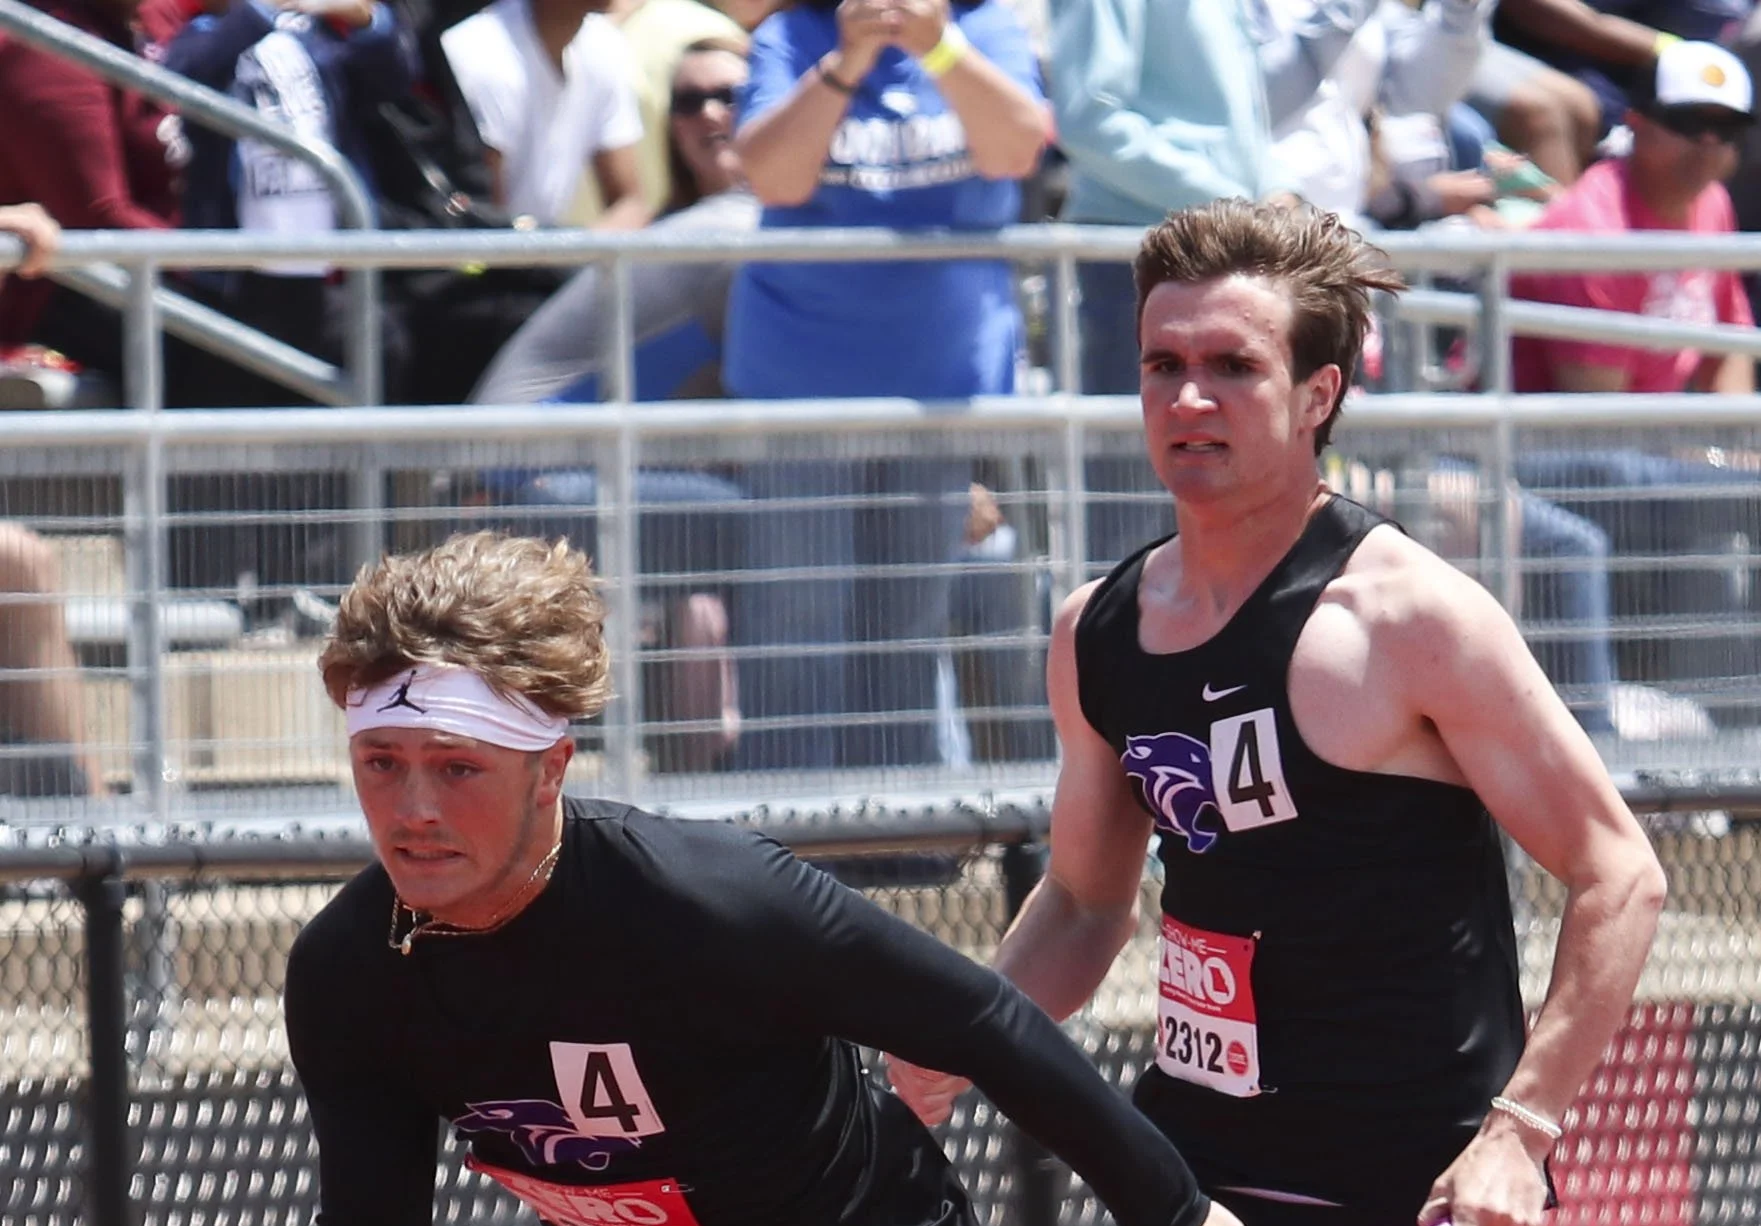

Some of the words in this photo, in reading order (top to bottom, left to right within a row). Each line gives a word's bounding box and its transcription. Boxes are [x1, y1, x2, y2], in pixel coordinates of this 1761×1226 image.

[1228, 719, 1276, 818] 4
[1165, 1016, 1225, 1074] 2312
[579, 1051, 640, 1133] 4
